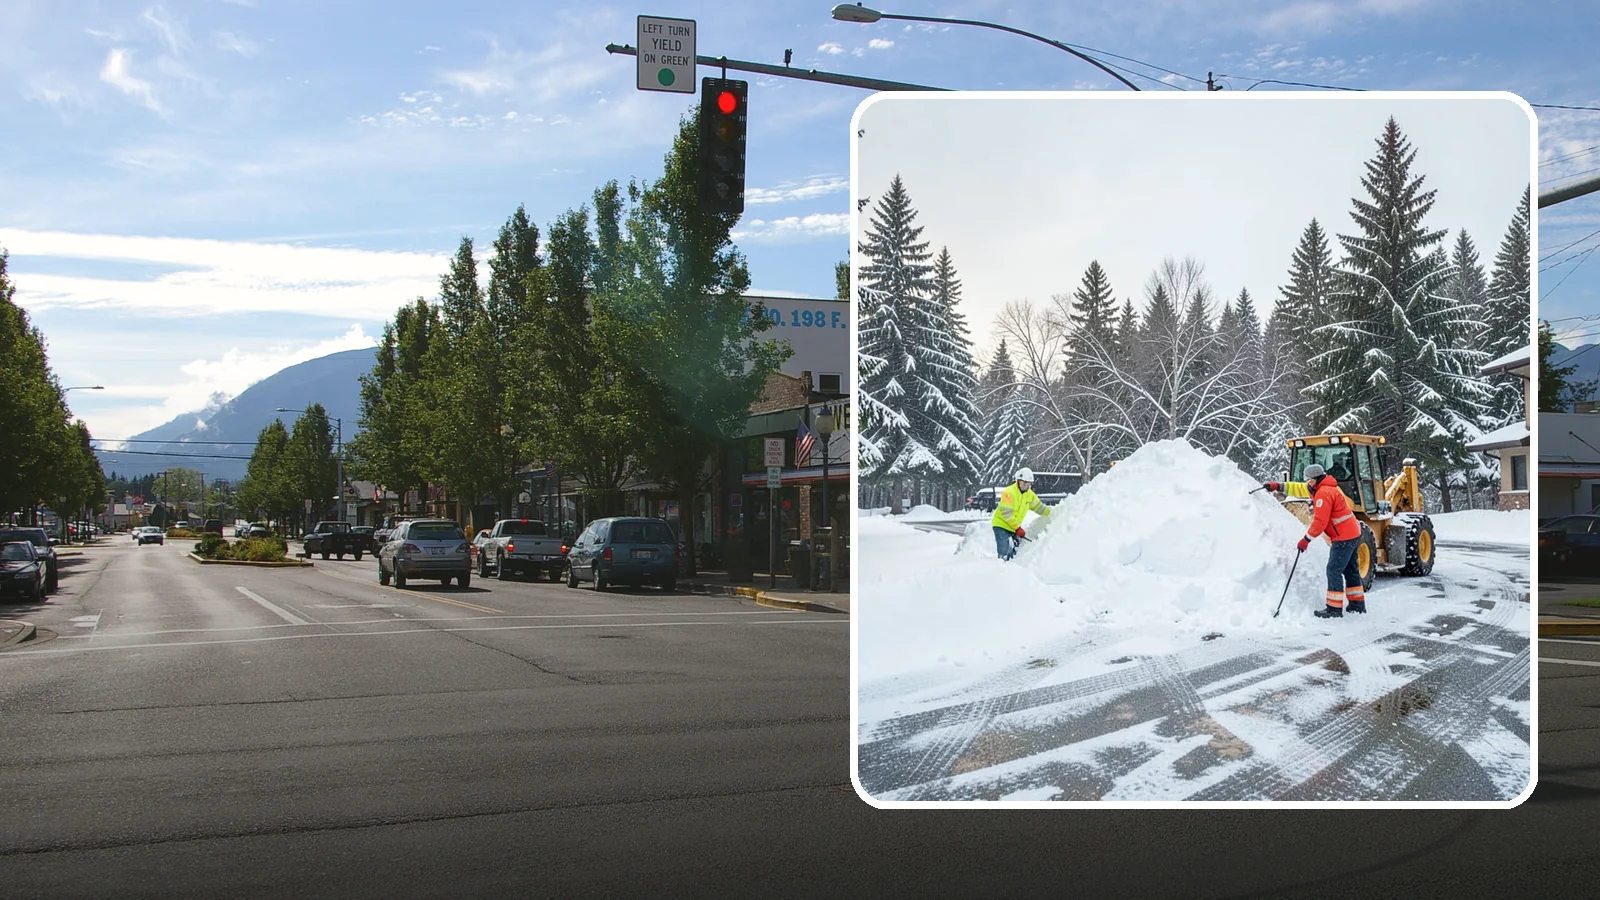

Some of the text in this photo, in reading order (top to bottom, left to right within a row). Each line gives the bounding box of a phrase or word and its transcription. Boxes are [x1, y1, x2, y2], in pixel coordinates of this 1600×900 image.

[643, 24, 690, 36] LEFT TURN
[652, 38, 682, 52] YIELD
[644, 53, 689, 66] ON GREEN
[791, 309, 826, 328] 198
[831, 311, 846, 328] F.
